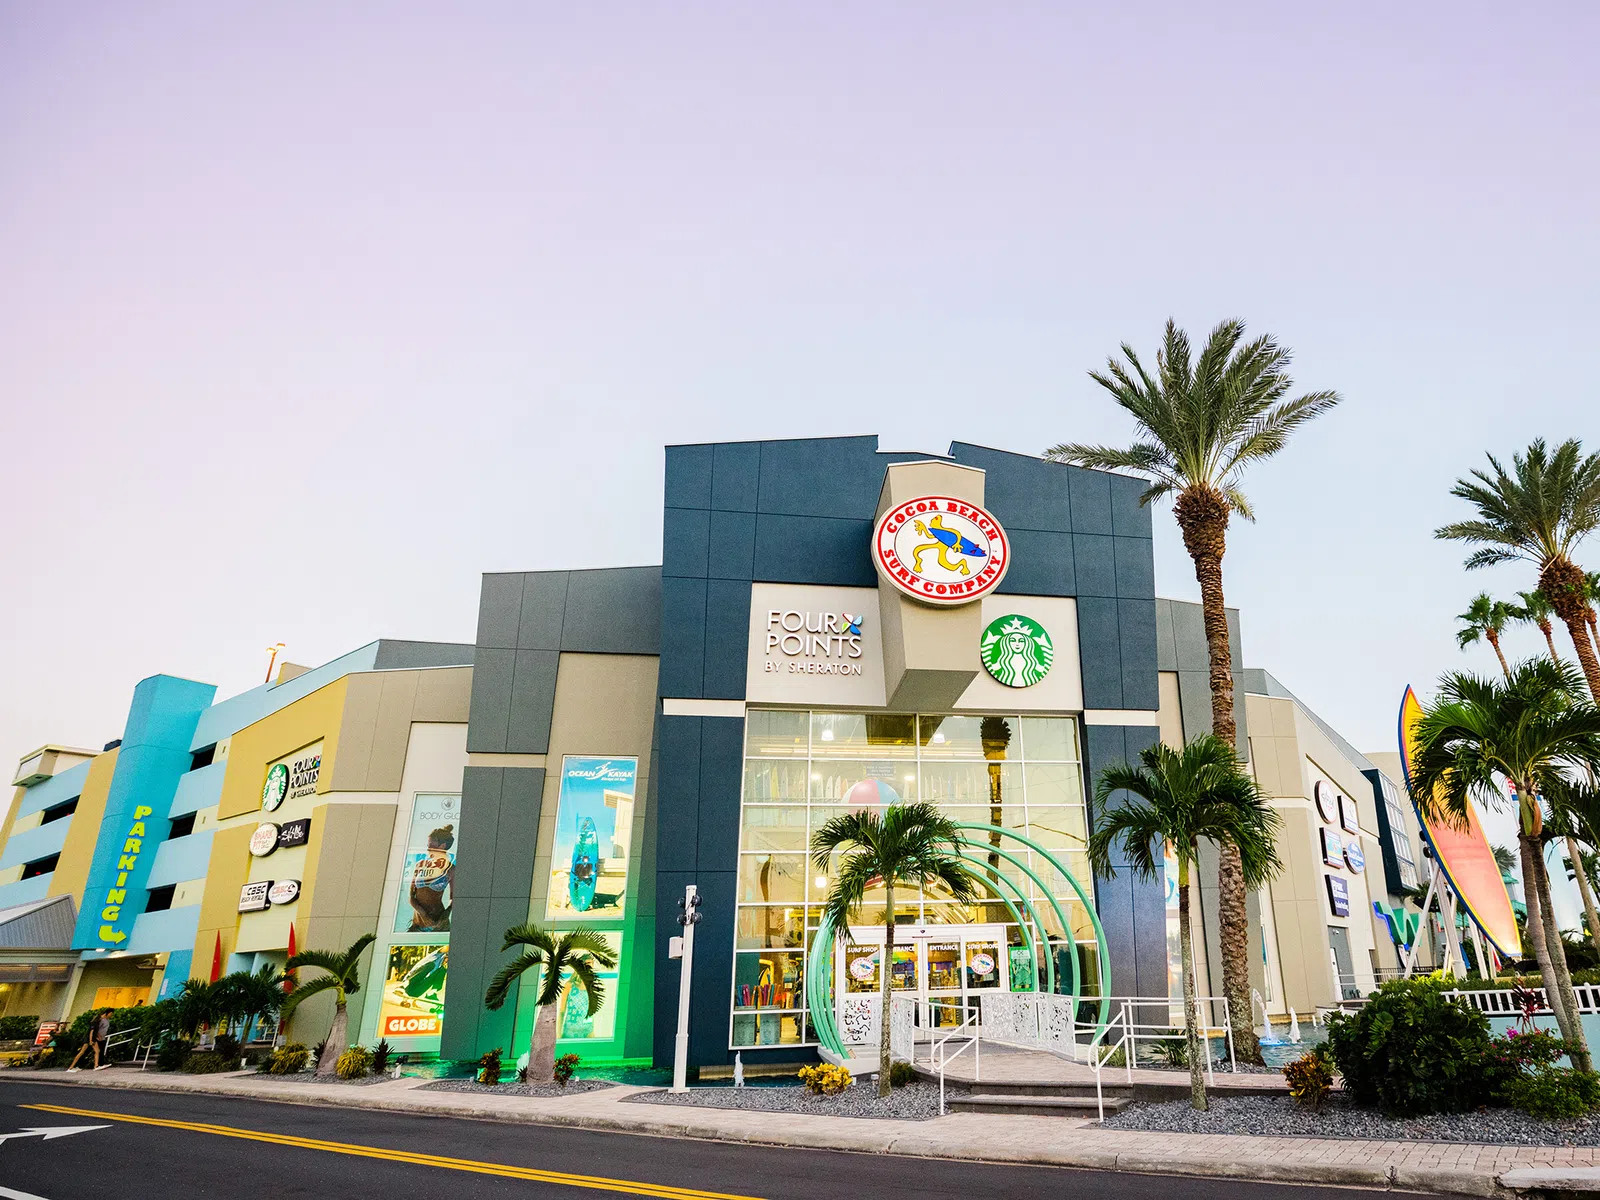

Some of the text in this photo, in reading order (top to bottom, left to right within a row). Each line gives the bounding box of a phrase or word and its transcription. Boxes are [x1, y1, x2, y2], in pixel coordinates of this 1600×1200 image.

[886, 501, 998, 541] COCOA BEACH
[884, 549, 1001, 595] SURF COMPANY
[767, 610, 840, 634] FOUR
[765, 633, 862, 658] POINTS
[765, 661, 862, 676] BY SHERATON
[293, 757, 314, 774] FOUR
[290, 768, 319, 790] POINTS
[420, 812, 442, 821] BODY
[101, 805, 153, 922] PARKING
[388, 1018, 436, 1032] GLOBE
